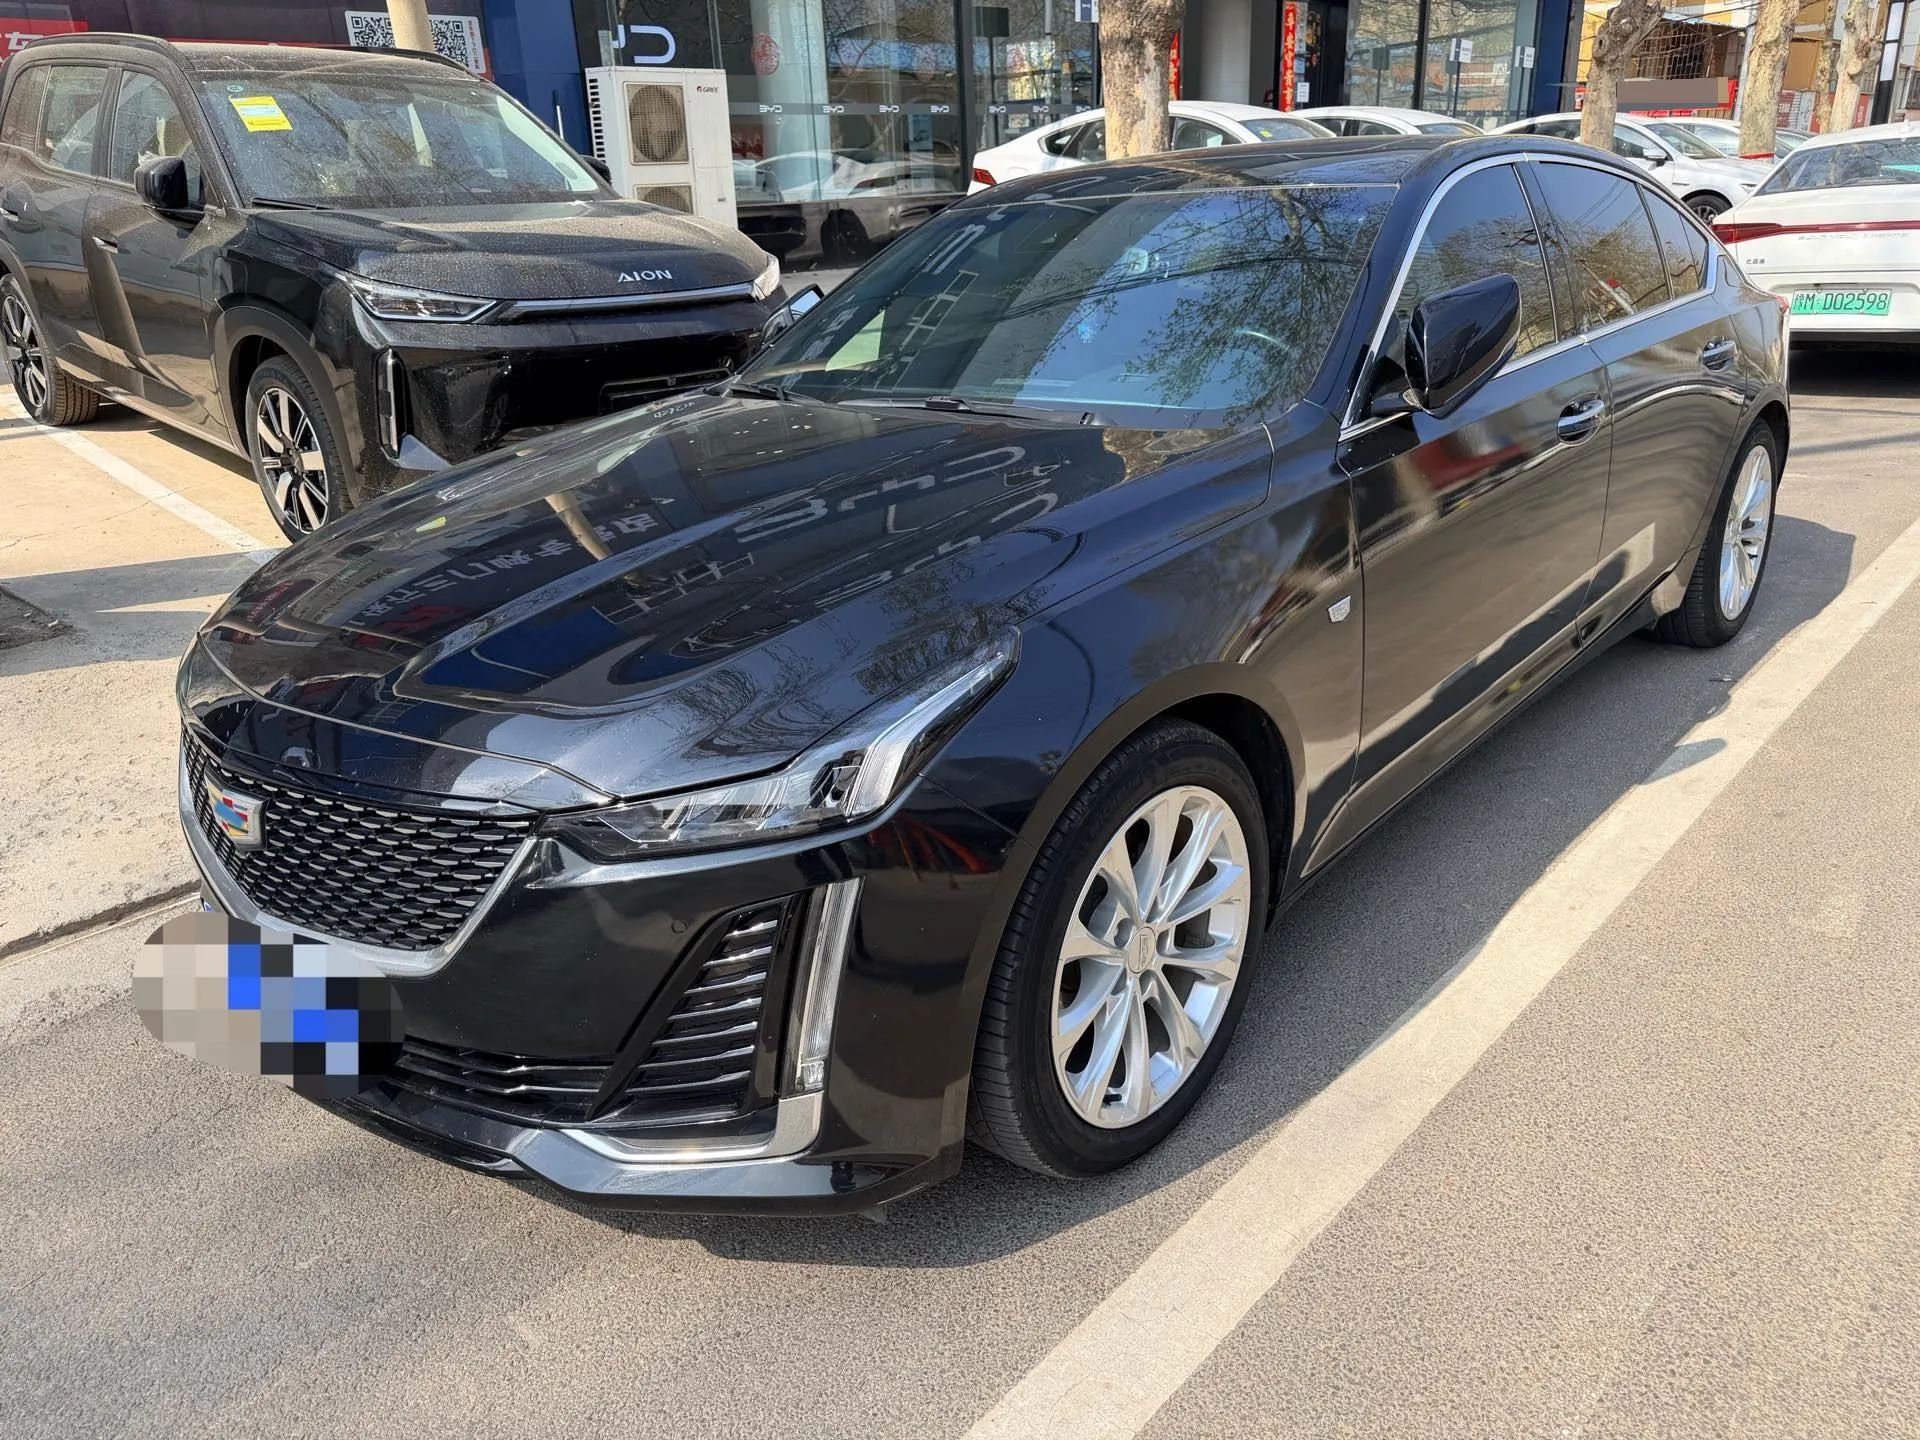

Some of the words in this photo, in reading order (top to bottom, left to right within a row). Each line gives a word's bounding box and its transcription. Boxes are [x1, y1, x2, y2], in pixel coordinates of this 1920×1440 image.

[759, 104, 783, 113] BYD
[822, 105, 845, 114] BYD
[879, 104, 900, 113] BYD
[930, 104, 950, 113] BYD
[988, 105, 1006, 113] BYD
[617, 269, 673, 283] AION
[1822, 292, 1889, 312] D02598
